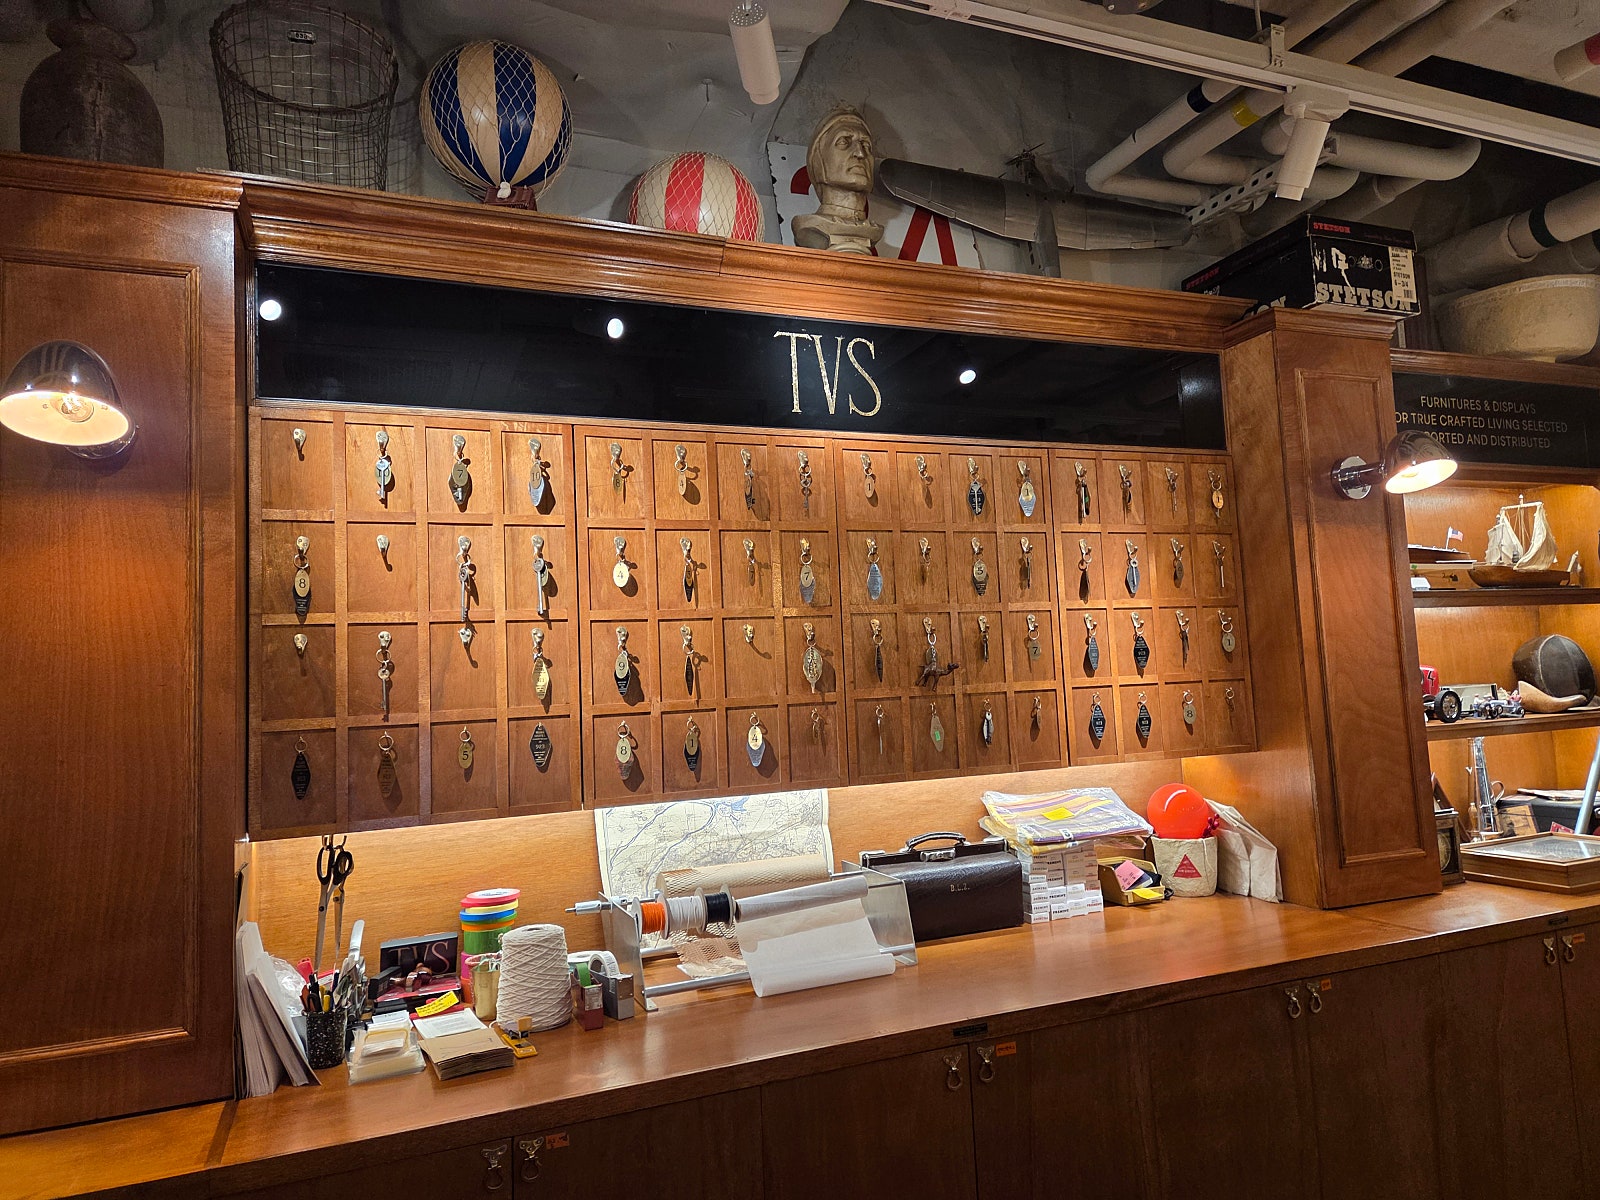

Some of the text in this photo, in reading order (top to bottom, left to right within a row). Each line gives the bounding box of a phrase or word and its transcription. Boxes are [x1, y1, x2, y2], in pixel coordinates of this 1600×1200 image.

[1313, 222, 1351, 233] STETSON
[773, 330, 882, 417] TVS
[1420, 395, 1536, 415] FURNITURES & DISPLAYS
[1411, 412, 1438, 426] TRUE
[1440, 414, 1485, 428] CRAFTED
[1487, 417, 1520, 431] LIVING
[1521, 420, 1568, 433] SELECTED
[1466, 433, 1488, 446] AND
[1490, 435, 1551, 449] DISTRIBUTED
[457, 469, 464, 479] 7
[531, 472, 540, 482] 10
[803, 571, 810, 581] 7
[977, 566, 984, 576] 5
[299, 578, 306, 589] 8
[619, 661, 626, 671] 9
[1186, 710, 1193, 718] 8
[752, 733, 758, 742] 4
[620, 744, 628, 755] 8
[462, 750, 469, 760] 5
[388, 940, 450, 975] TVS
